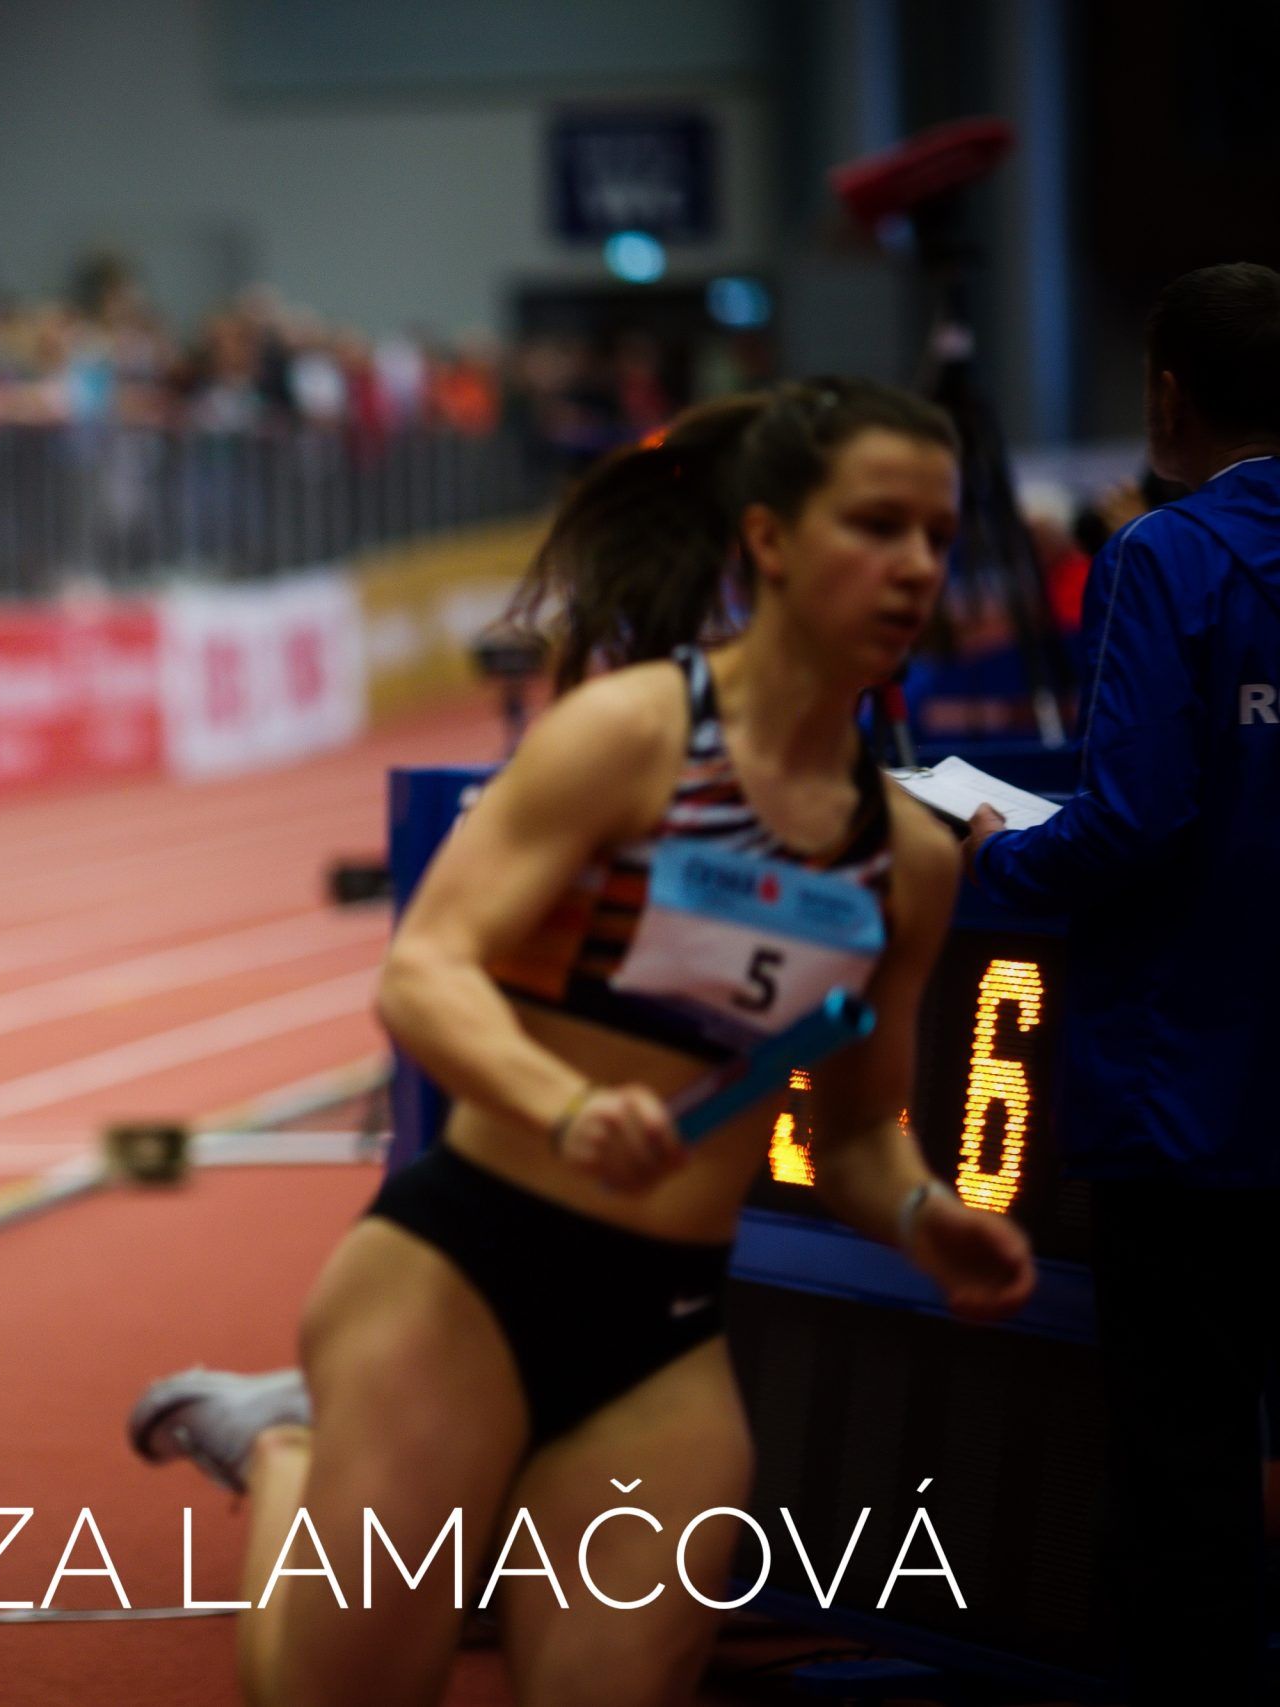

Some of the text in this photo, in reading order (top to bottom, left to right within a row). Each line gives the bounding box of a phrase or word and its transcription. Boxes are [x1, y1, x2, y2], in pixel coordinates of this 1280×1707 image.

[1239, 683, 1280, 725] R
[731, 947, 786, 1014] 5
[955, 959, 1044, 1214] 6
